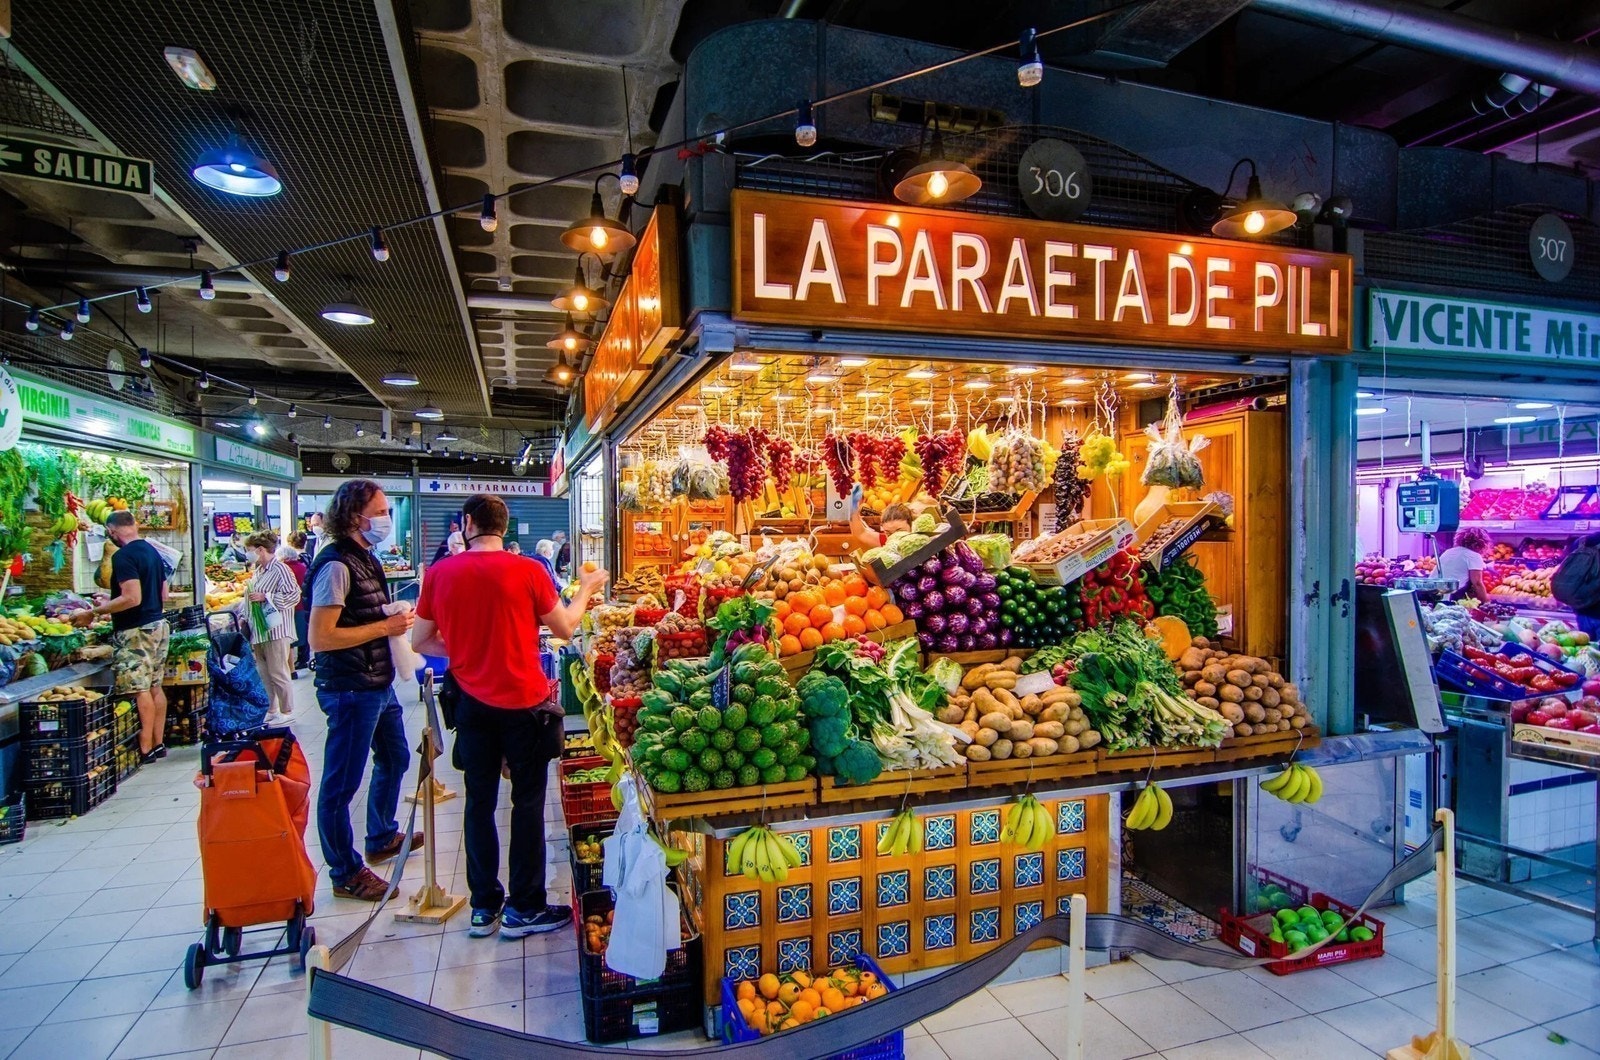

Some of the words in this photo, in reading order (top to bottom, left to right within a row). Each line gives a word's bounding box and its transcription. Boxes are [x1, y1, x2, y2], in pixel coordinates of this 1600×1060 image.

[34, 149, 142, 189] SALIDA
[1028, 165, 1081, 200] 306
[1537, 236, 1567, 263] 307
[753, 213, 846, 304] LA
[867, 225, 1153, 325] PARAETA
[1167, 253, 1236, 330] DE
[1254, 261, 1339, 338] PILI
[1378, 297, 1531, 352] VICENTE
[17, 384, 70, 418] VIRGINIA
[334, 457, 347, 465] 275
[444, 482, 537, 493] PARAFARMACIA
[1335, 949, 1346, 957] PILI
